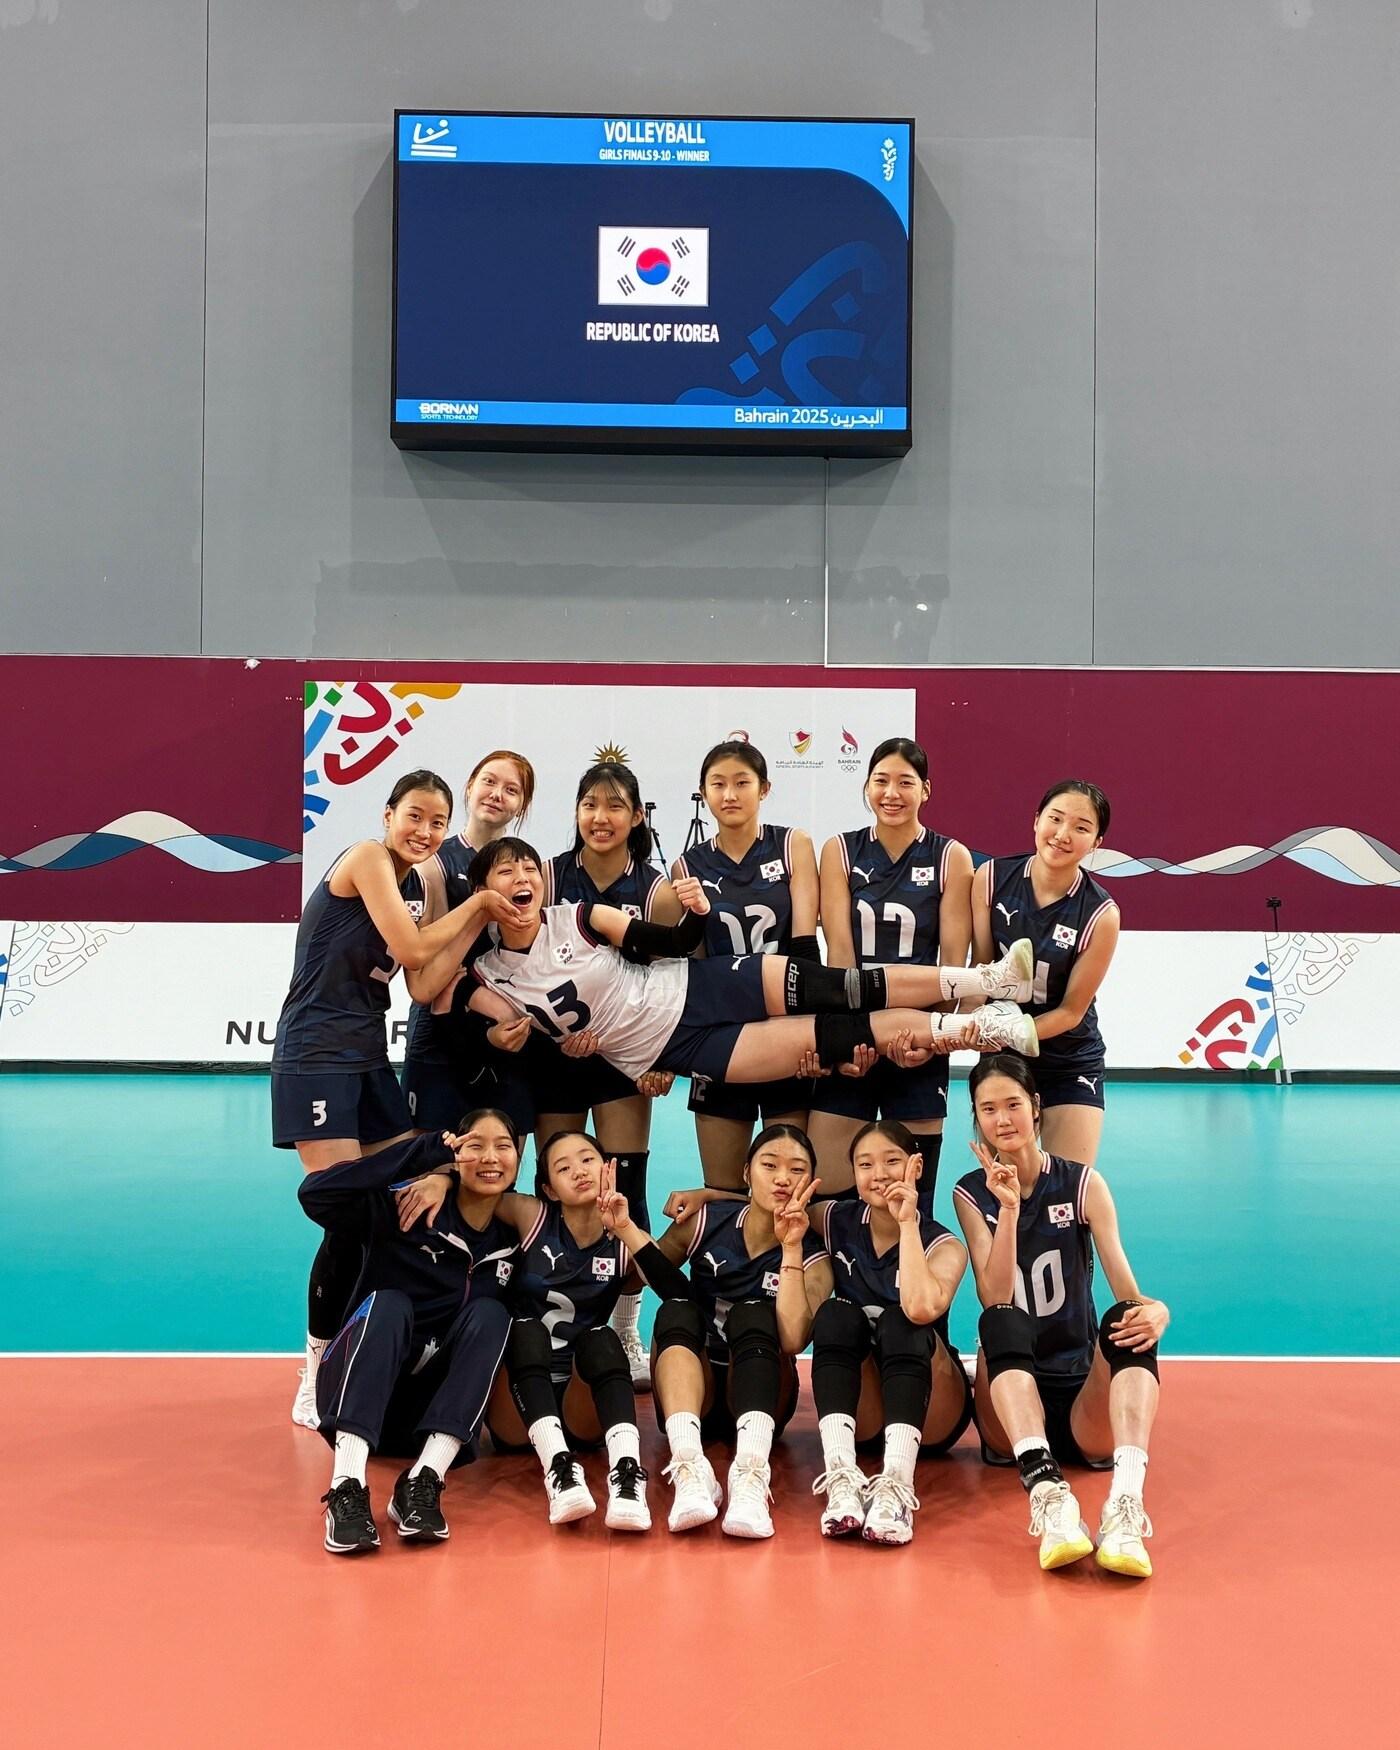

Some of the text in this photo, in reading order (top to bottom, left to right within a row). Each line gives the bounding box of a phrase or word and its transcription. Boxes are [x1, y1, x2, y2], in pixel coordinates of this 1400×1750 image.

[604, 121, 706, 144] VOLLEYBALL
[599, 148, 623, 160] GIRLS
[623, 149, 652, 161] FINALS
[653, 150, 671, 161] 9-10
[676, 150, 710, 162] WINNER
[586, 322, 720, 343] REPUBLIC OF KOREA
[419, 402, 479, 415] BORNAN
[734, 407, 829, 424] Bahrain 2025
[830, 408, 884, 428] البحرين
[719, 903, 779, 955] 12
[856, 899, 916, 958] 17
[311, 1100, 328, 1127] 3
[1056, 1221, 1071, 1229] KOR
[595, 1274, 610, 1282] KOR
